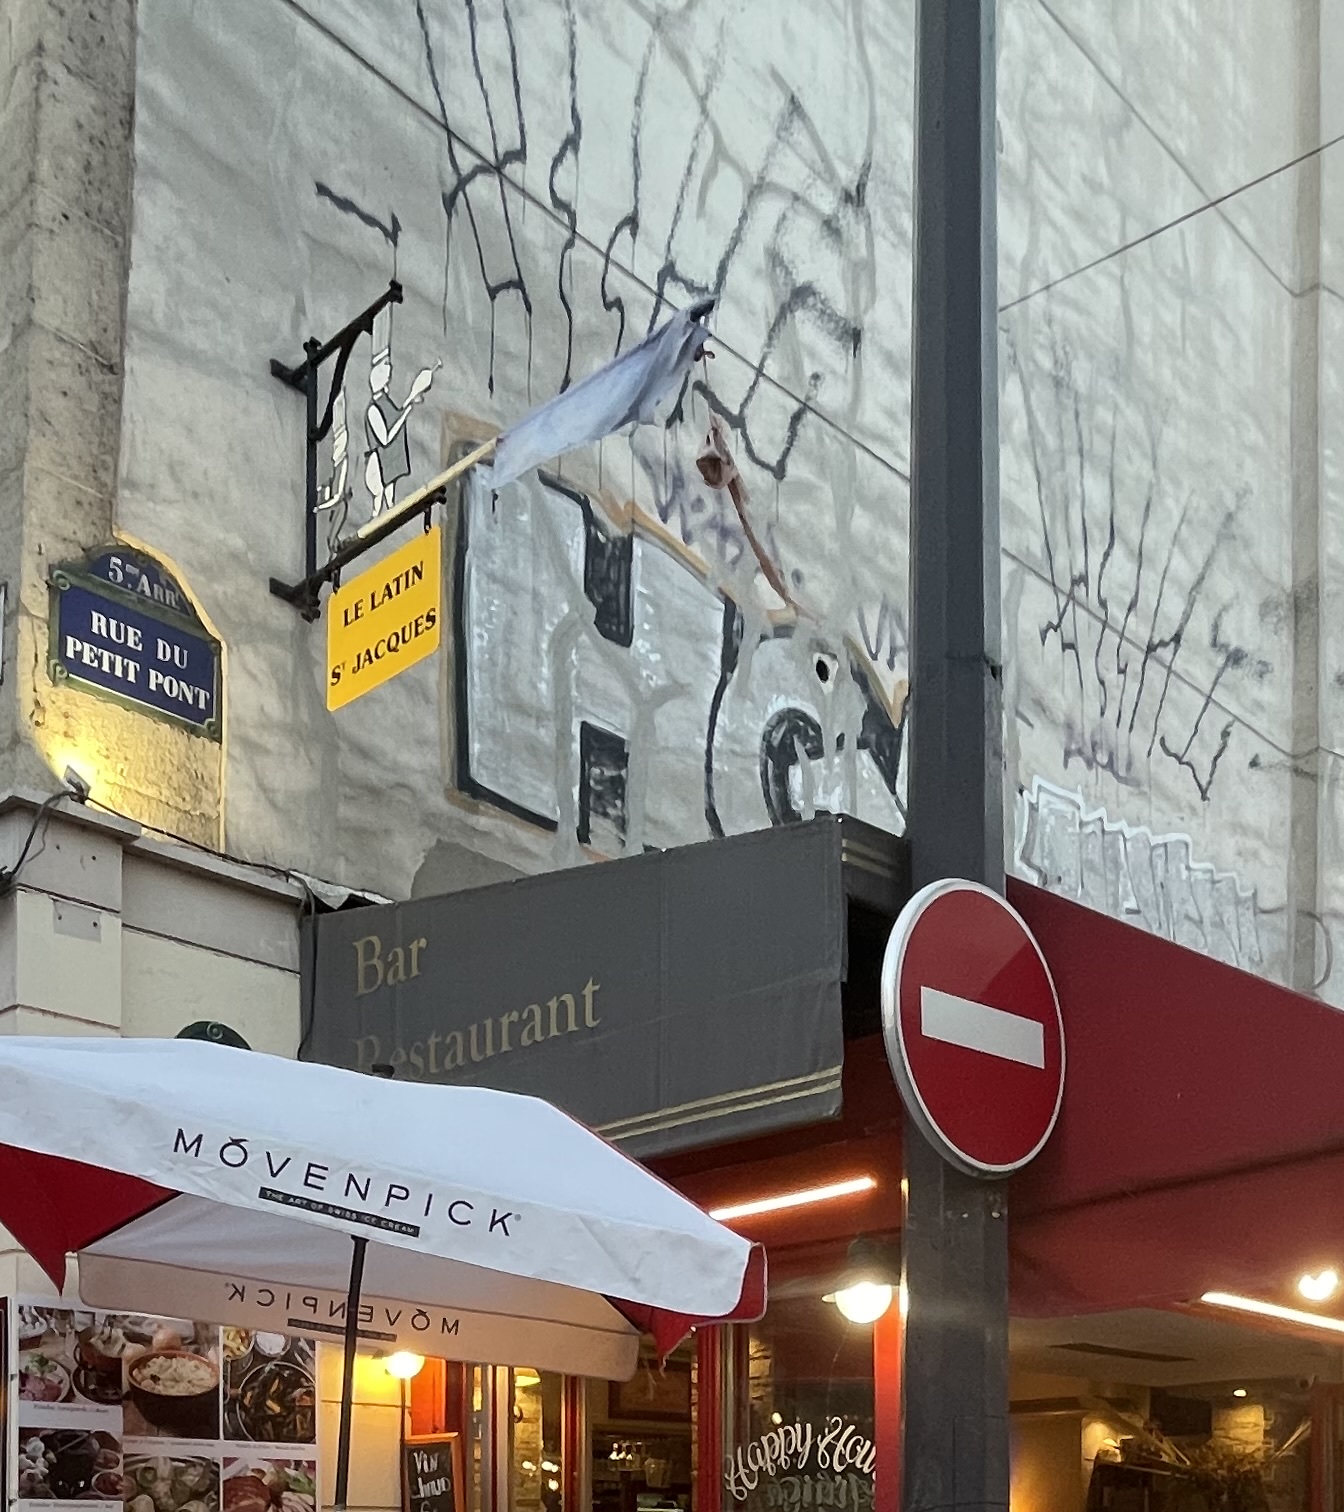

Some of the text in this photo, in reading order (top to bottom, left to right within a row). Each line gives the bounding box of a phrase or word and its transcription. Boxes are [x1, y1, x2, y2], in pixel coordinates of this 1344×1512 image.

[343, 560, 424, 628] LE LATIN
[66, 635, 210, 710] PETIT PONT
[90, 610, 188, 669] RUE DU
[351, 606, 437, 675] JACQUES
[353, 935, 428, 997] Bar
[355, 976, 602, 1080] Restaurant
[265, 1190, 284, 1203] THE
[724, 1423, 812, 1501] Happy
[817, 1416, 876, 1473] Hou
